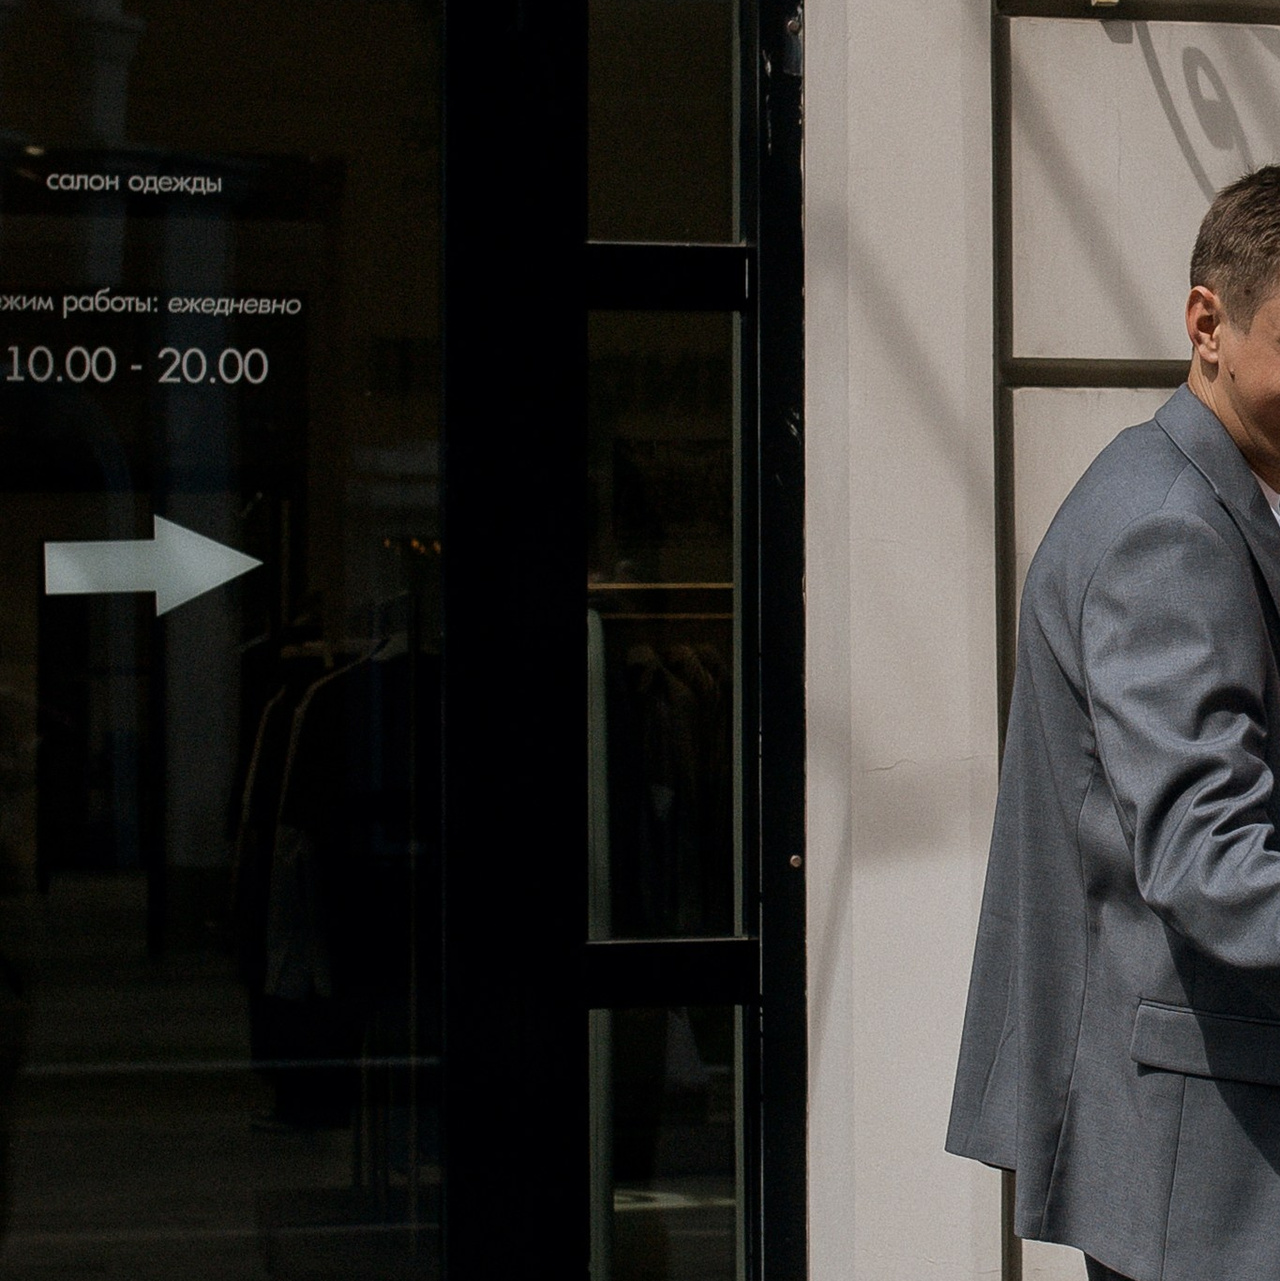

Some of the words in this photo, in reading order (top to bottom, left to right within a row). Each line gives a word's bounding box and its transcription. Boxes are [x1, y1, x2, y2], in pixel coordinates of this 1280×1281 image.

[46, 173, 119, 191] салон
[127, 174, 222, 195] одежды
[0, 294, 54, 312] жим
[62, 287, 158, 319] работы:
[167, 296, 302, 316] ежедневно
[6, 345, 117, 383] 10.00
[157, 347, 269, 384] 20.00
